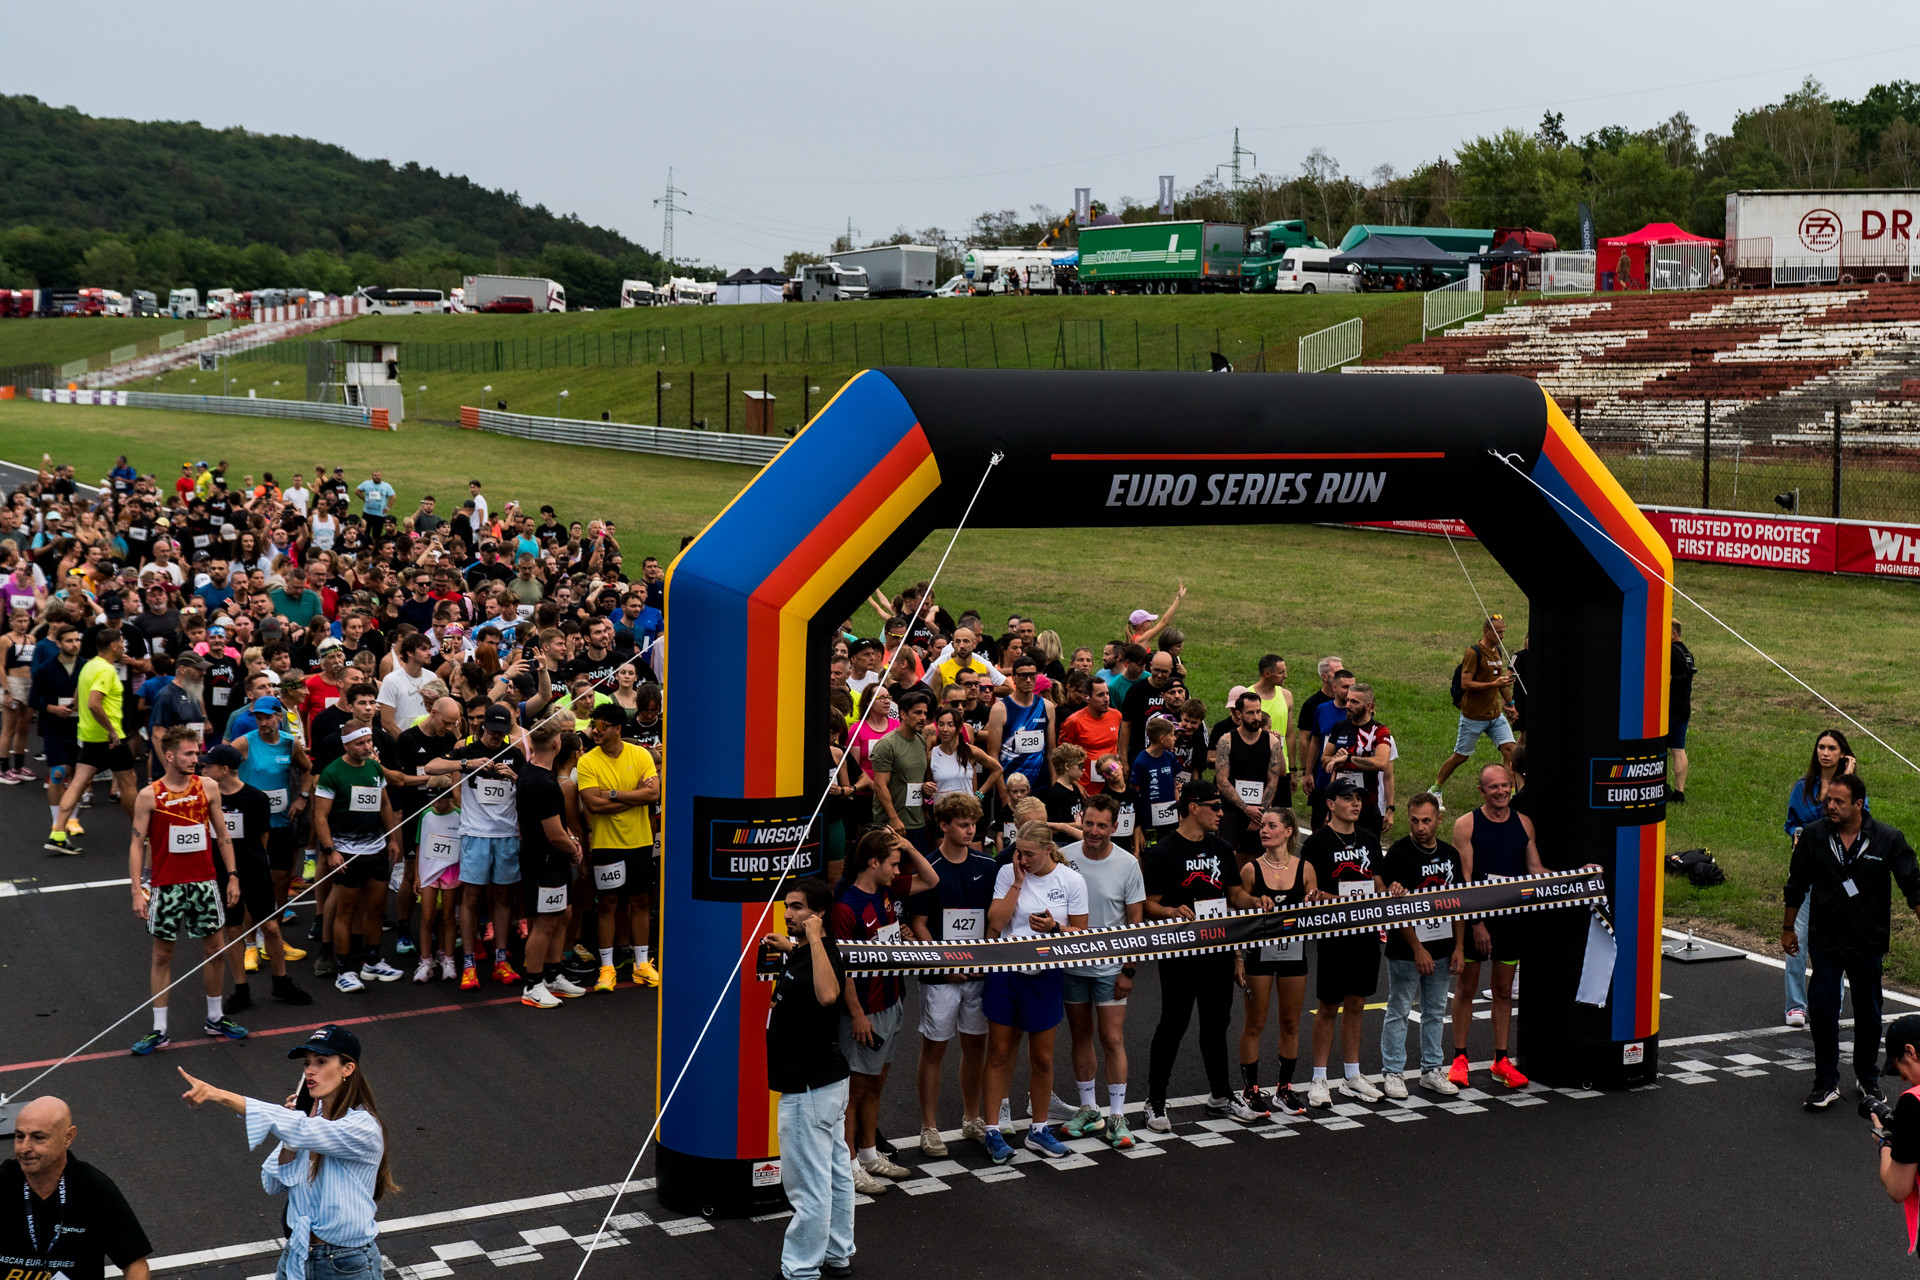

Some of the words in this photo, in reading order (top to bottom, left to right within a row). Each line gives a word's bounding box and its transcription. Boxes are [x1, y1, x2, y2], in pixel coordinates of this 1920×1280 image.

[1861, 209, 1920, 241] DR
[1105, 474, 1197, 507] EURO
[1200, 473, 1312, 506] SERIES
[1314, 472, 1387, 504] RUN
[1427, 522, 1454, 533] COMPANY
[1454, 525, 1466, 534] INC.
[1670, 518, 1732, 536] TRUSTED
[1733, 522, 1753, 539] TO
[1755, 524, 1821, 544] PROTECT
[1677, 538, 1714, 556] FIRST
[1716, 541, 1811, 565] RESPONDERS
[212, 666, 227, 676] RUN
[588, 668, 608, 680] RUN
[1021, 737, 1039, 747] 238
[1627, 760, 1664, 778] NASCAR
[484, 786, 505, 797] 570
[1241, 787, 1259, 798] 575
[1607, 788, 1638, 802] EURO
[1640, 784, 1664, 801] SERIES
[357, 794, 377, 804] 530
[1158, 809, 1174, 819] 554
[176, 833, 200, 845] 829
[754, 824, 811, 844] NASCAR
[432, 842, 451, 855] 371
[730, 856, 769, 873] EURO
[772, 852, 812, 872] SERIES
[1333, 850, 1359, 863] RUN
[1186, 857, 1209, 871] RUN
[1421, 863, 1444, 876] RUN
[600, 869, 621, 883] 446
[1535, 881, 1584, 898] NASCAR
[546, 893, 564, 905] 447
[1297, 910, 1347, 929] NASCAR
[1350, 905, 1383, 922] EURO
[1386, 900, 1431, 917] SERIES
[1434, 897, 1461, 911] RUN
[952, 918, 976, 931] 427
[1052, 940, 1108, 956] NASCAR
[1111, 935, 1148, 951] EURO
[1150, 930, 1196, 946] SERIES
[1200, 926, 1226, 941] RUN
[849, 951, 888, 964] EURO
[892, 951, 941, 962] SERIES
[943, 951, 974, 961] RUN
[25, 1258, 47, 1267] EUR
[48, 1260, 75, 1268] SERIES
